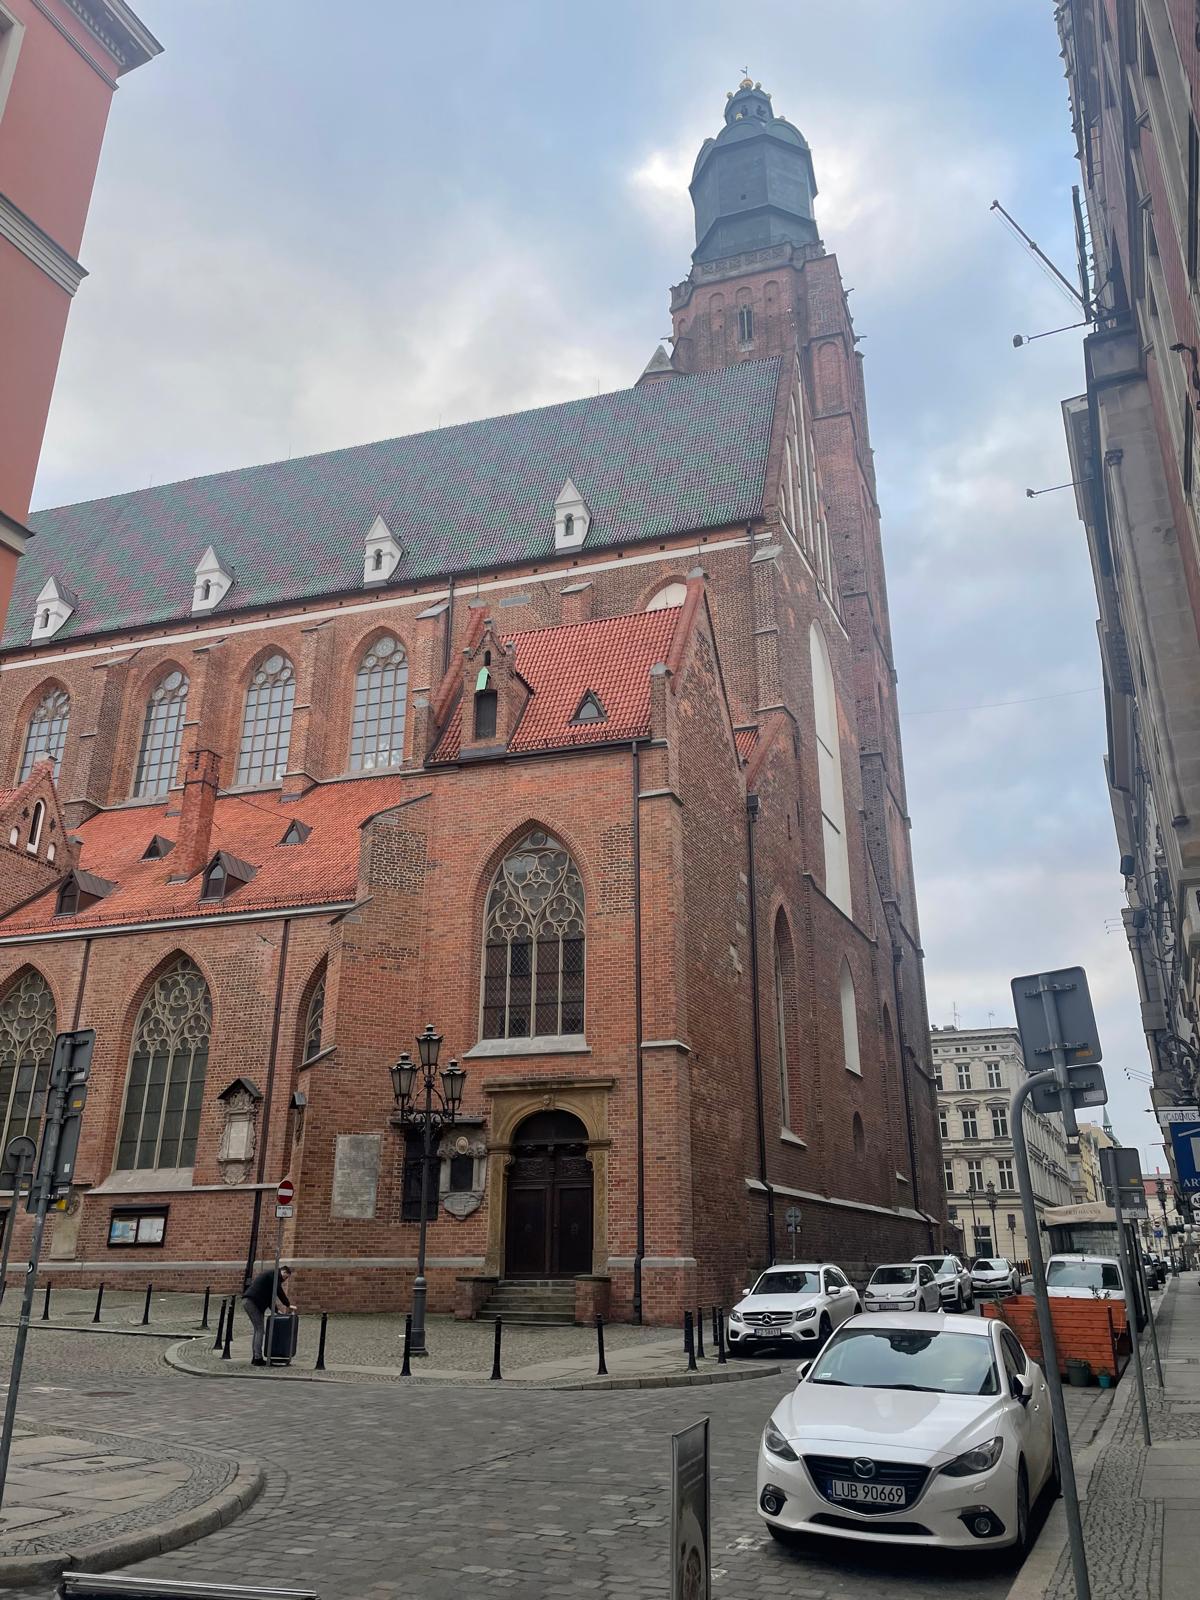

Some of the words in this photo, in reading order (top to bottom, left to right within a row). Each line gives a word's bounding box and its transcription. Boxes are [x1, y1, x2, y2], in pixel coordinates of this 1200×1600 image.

[1163, 1112, 1196, 1121] ACADEMUS
[1183, 1178, 1200, 1187] AR
[833, 1481, 858, 1498] LUB
[862, 1485, 903, 1502] 90669
